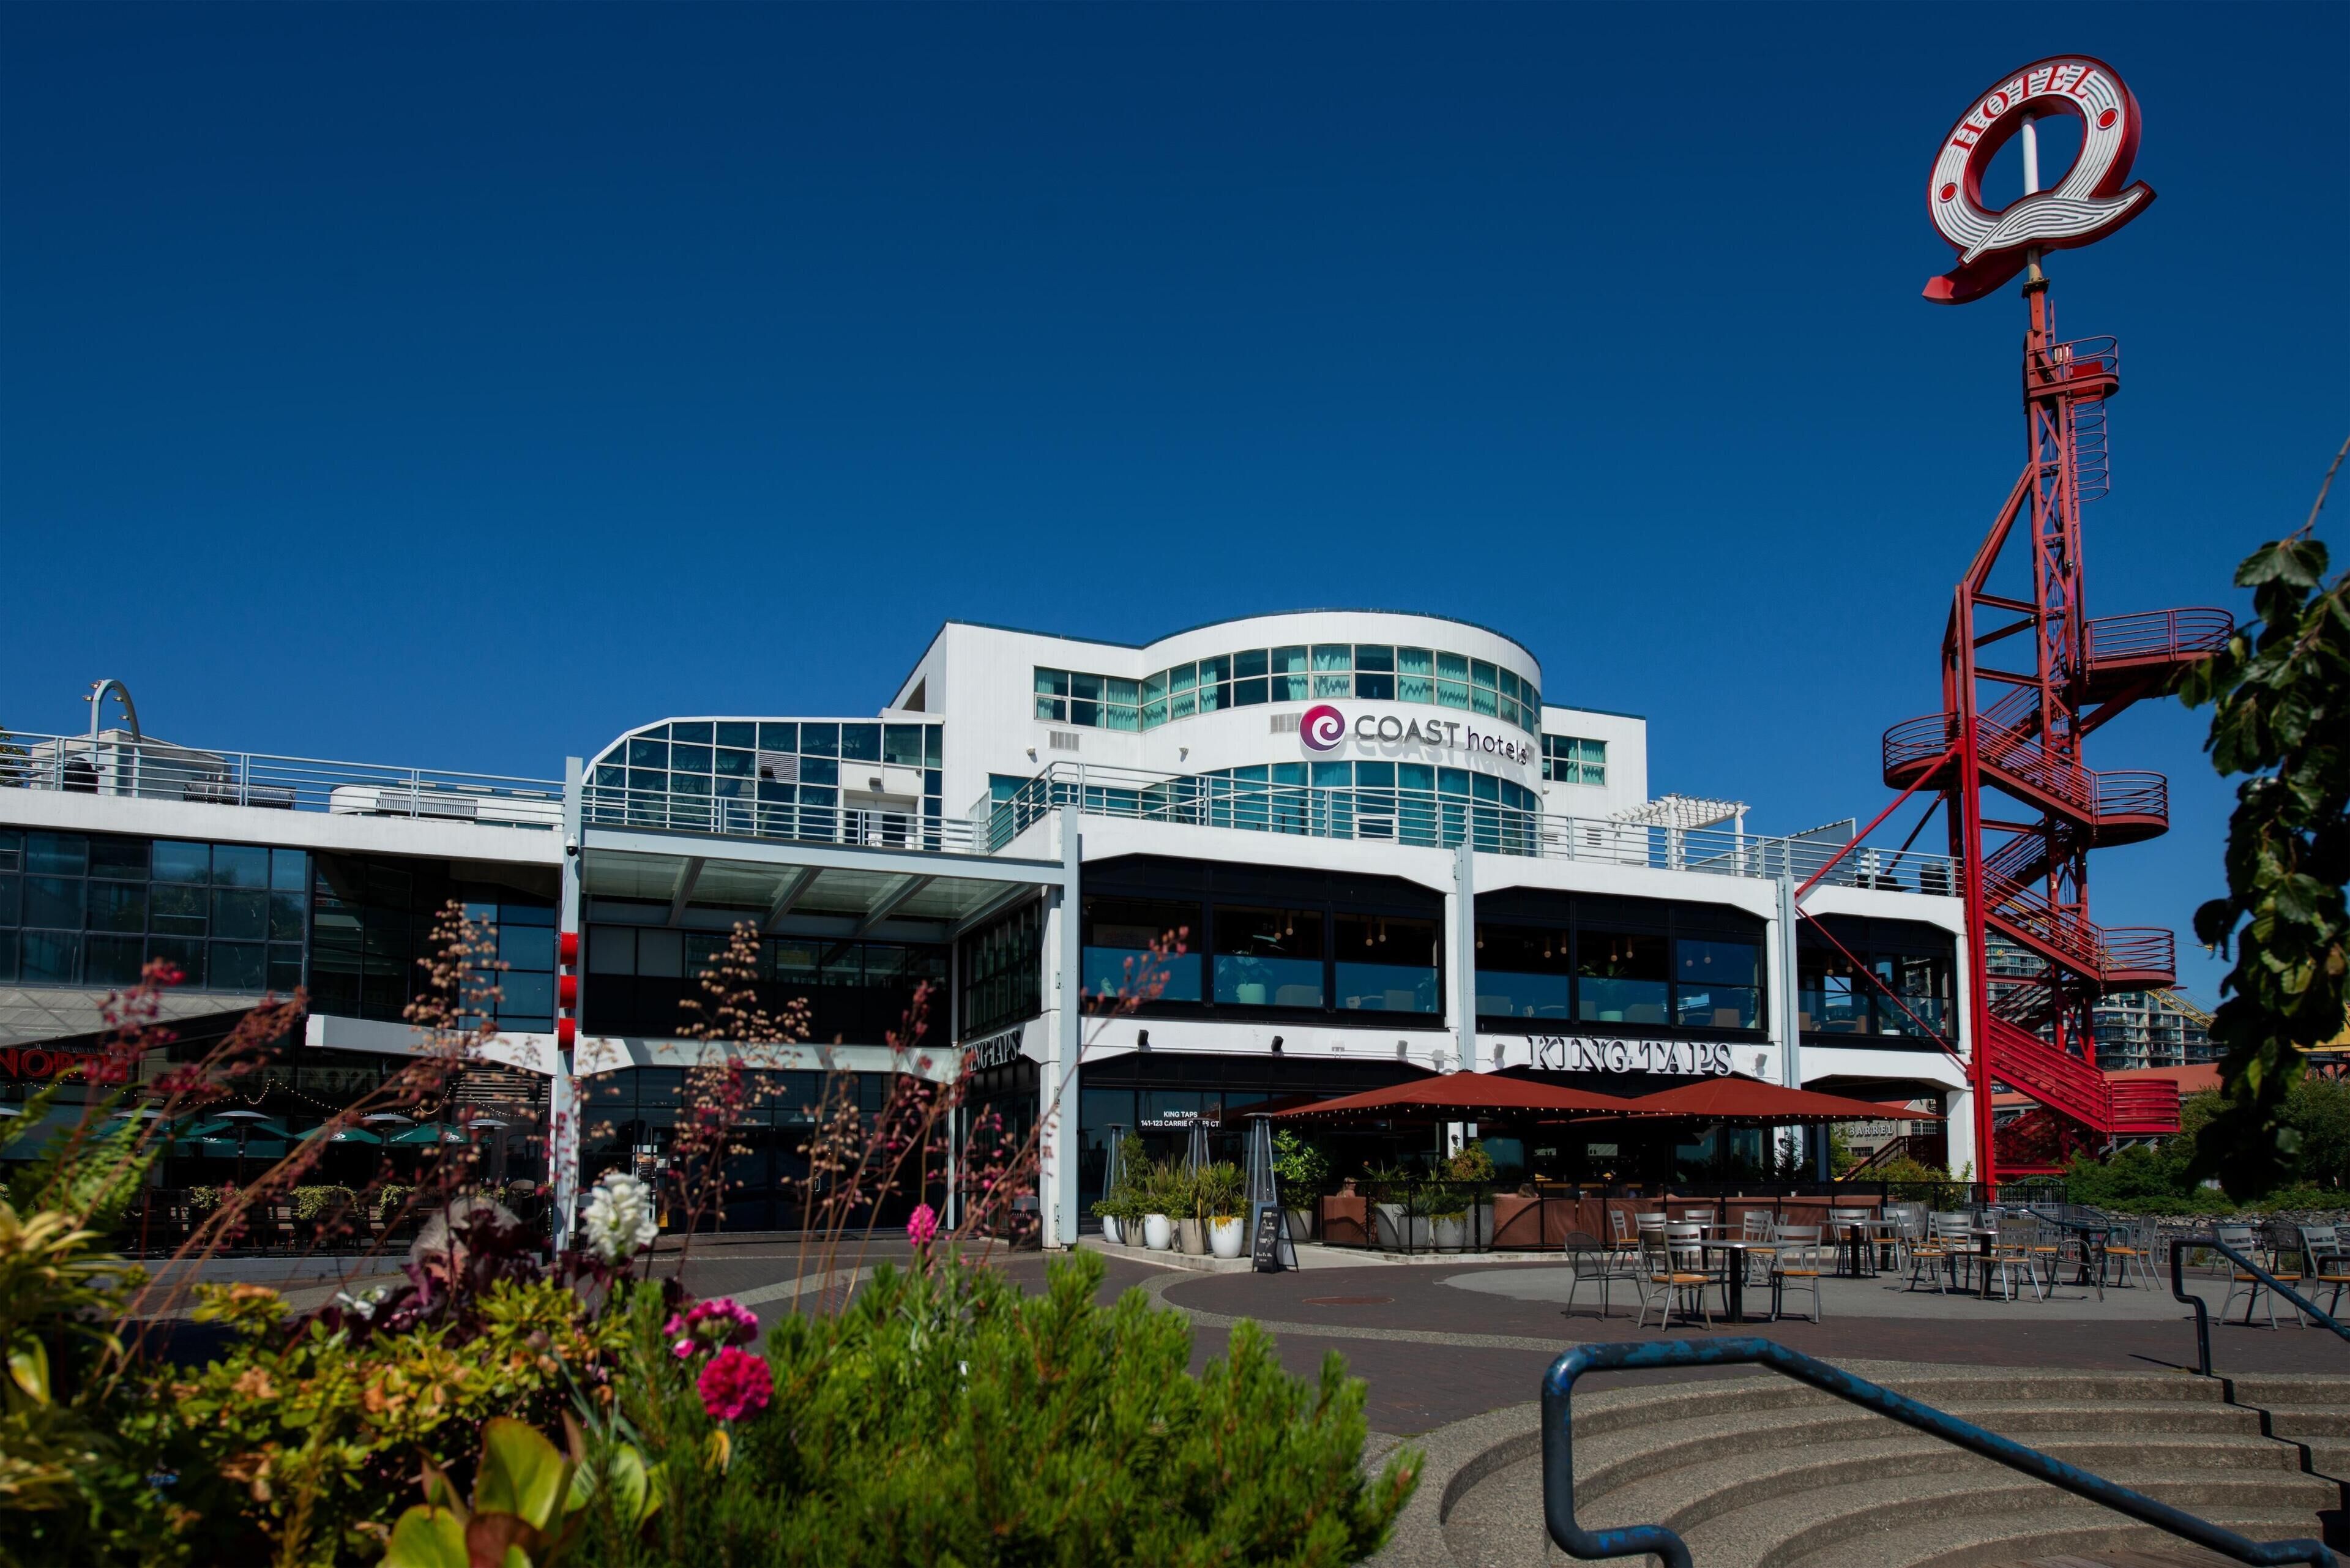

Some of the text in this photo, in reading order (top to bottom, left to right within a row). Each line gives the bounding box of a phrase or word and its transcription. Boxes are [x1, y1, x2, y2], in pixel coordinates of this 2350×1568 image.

[1950, 63, 2097, 153] HOTEL
[1354, 715, 1528, 765] COAST hotels
[990, 1031, 1019, 1066] TAPS
[1528, 1034, 1734, 1077] KING TAPS
[1849, 1125, 1893, 1136] BARREL
